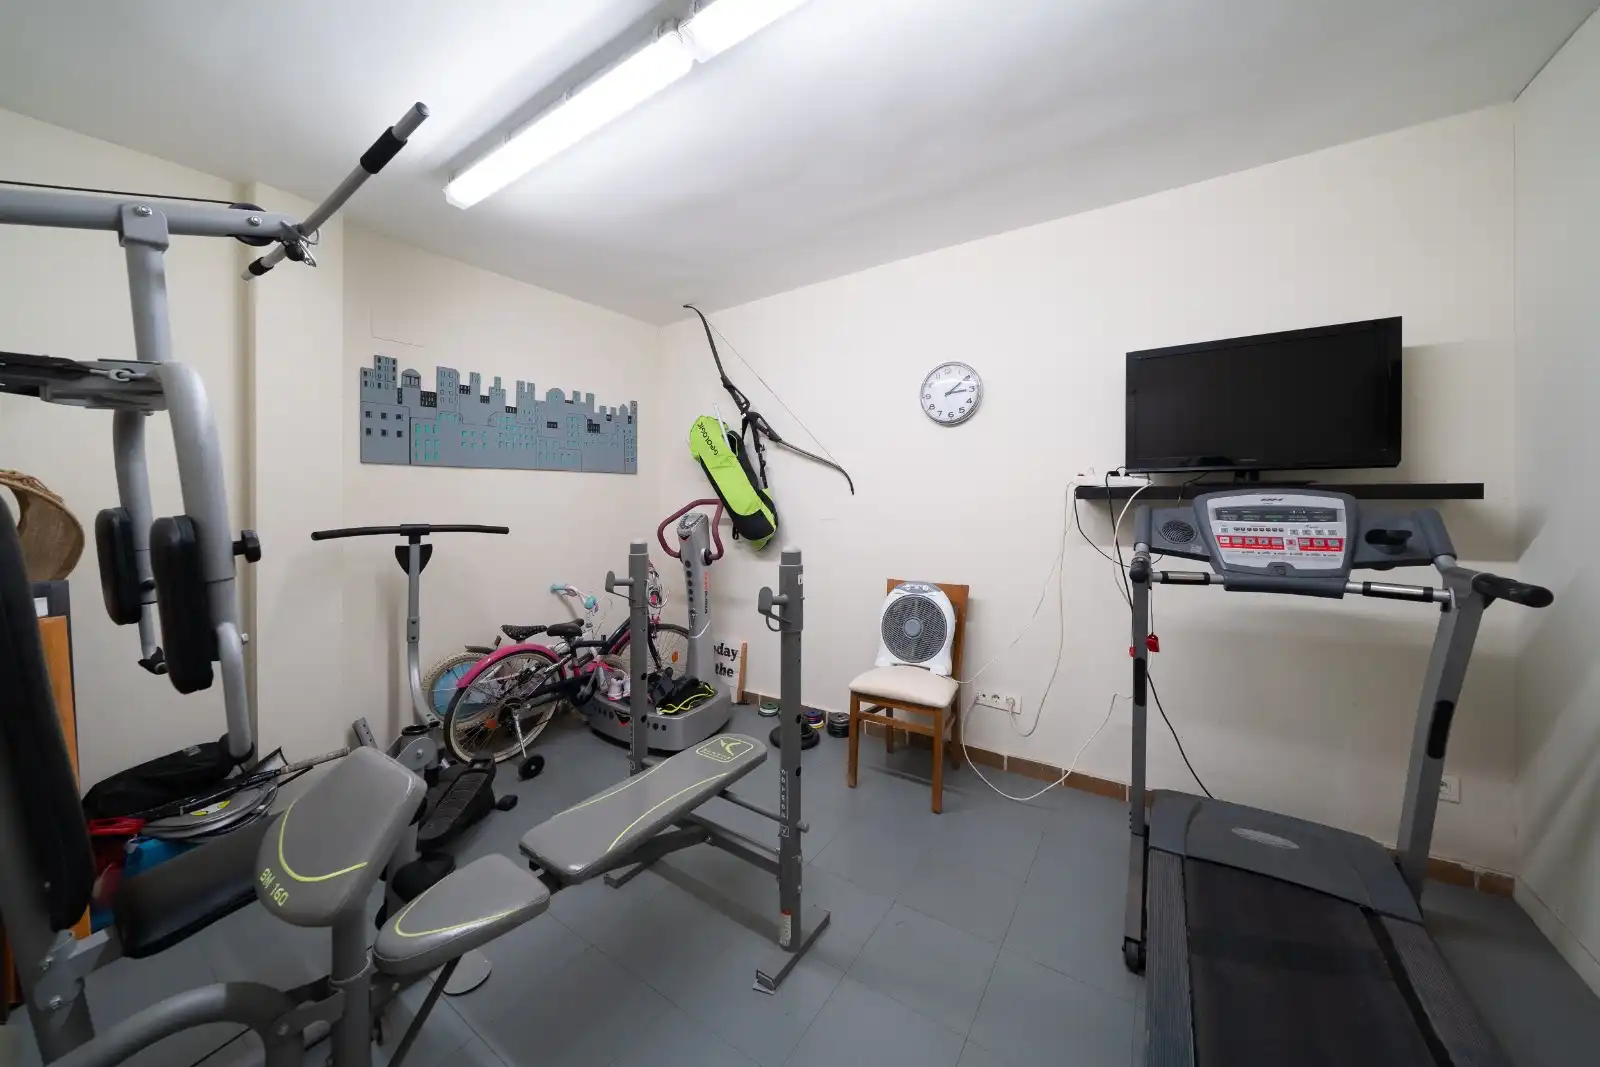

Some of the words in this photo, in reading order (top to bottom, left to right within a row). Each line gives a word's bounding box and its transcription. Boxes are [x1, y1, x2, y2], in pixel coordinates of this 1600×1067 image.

[714, 642, 739, 662] day
[715, 662, 734, 678] the
[260, 868, 276, 889] BM
[270, 883, 289, 907] 160
